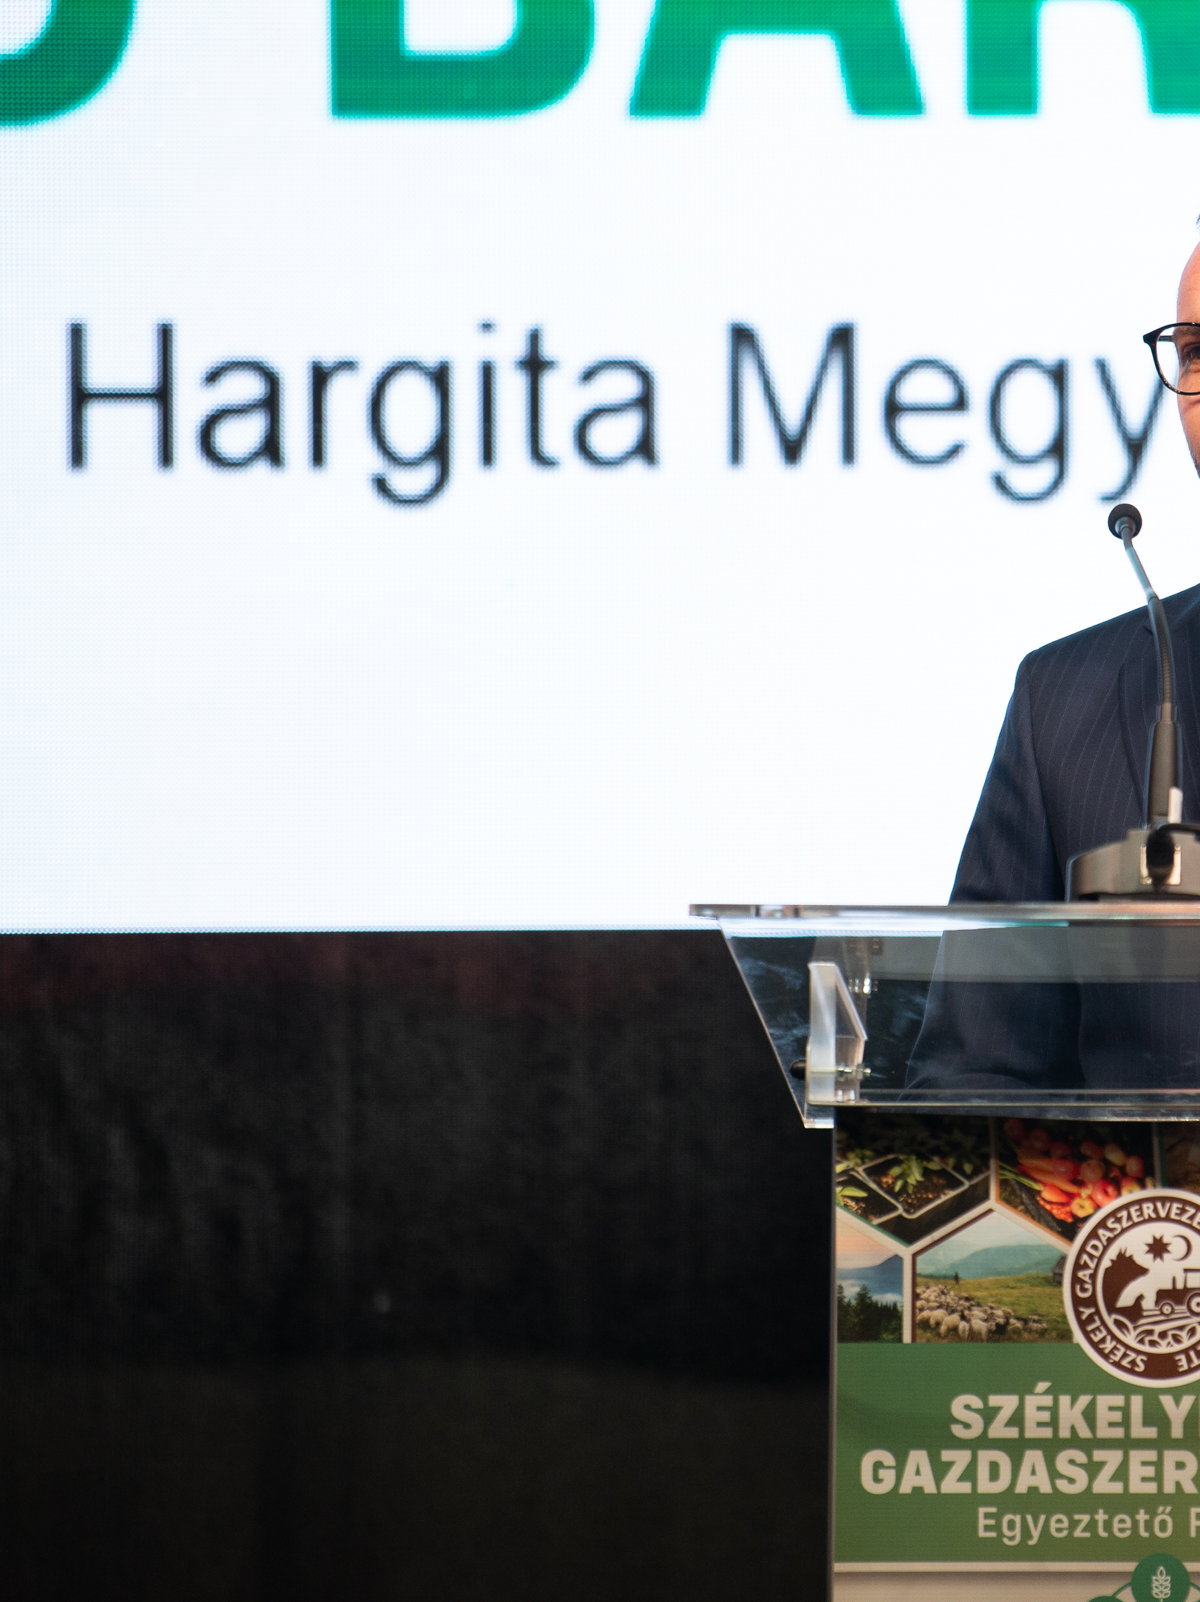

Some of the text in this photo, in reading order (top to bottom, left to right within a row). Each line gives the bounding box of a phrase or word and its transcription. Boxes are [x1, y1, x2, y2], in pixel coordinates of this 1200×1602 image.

[68, 322, 658, 507] Hargita
[729, 322, 1166, 502] Megy
[1079, 1306, 1148, 1372] SZÉKELY
[977, 1506, 1174, 1546] Egyeztető
